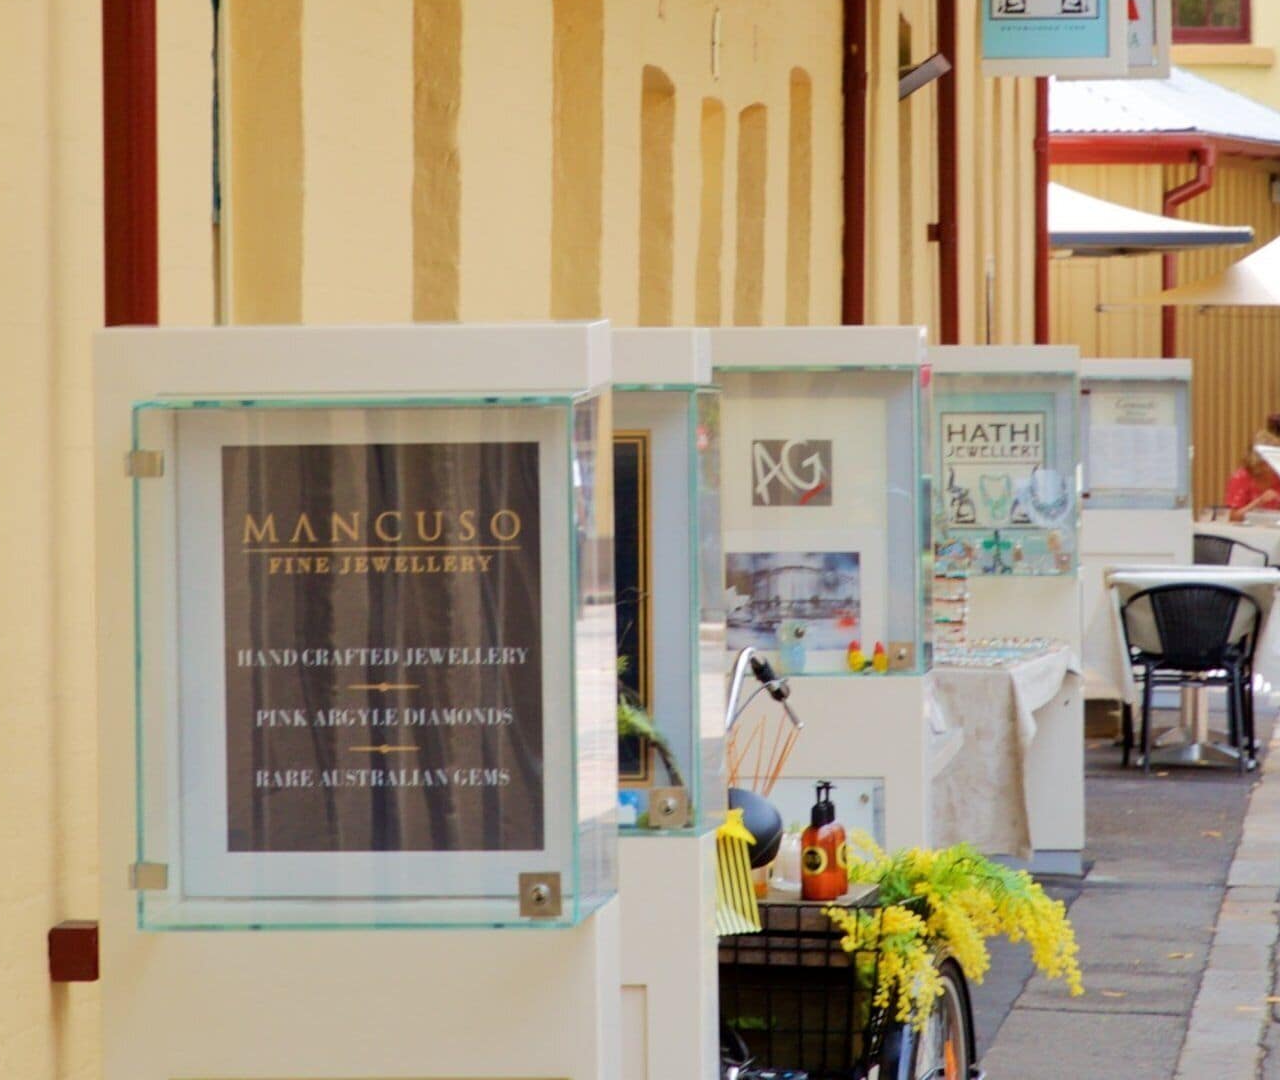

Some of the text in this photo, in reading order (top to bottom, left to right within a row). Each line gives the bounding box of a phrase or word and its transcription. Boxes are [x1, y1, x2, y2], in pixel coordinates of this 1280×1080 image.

[947, 423, 1040, 442] HATHI
[242, 509, 521, 544] MANCUSO
[270, 555, 493, 575] FINE JEWELLERY
[403, 646, 529, 667] JEWELLERY
[256, 706, 514, 728] PINK ARGYLE DIAMONDS
[256, 767, 512, 789] RARE AUSTRALIAN GEMS
